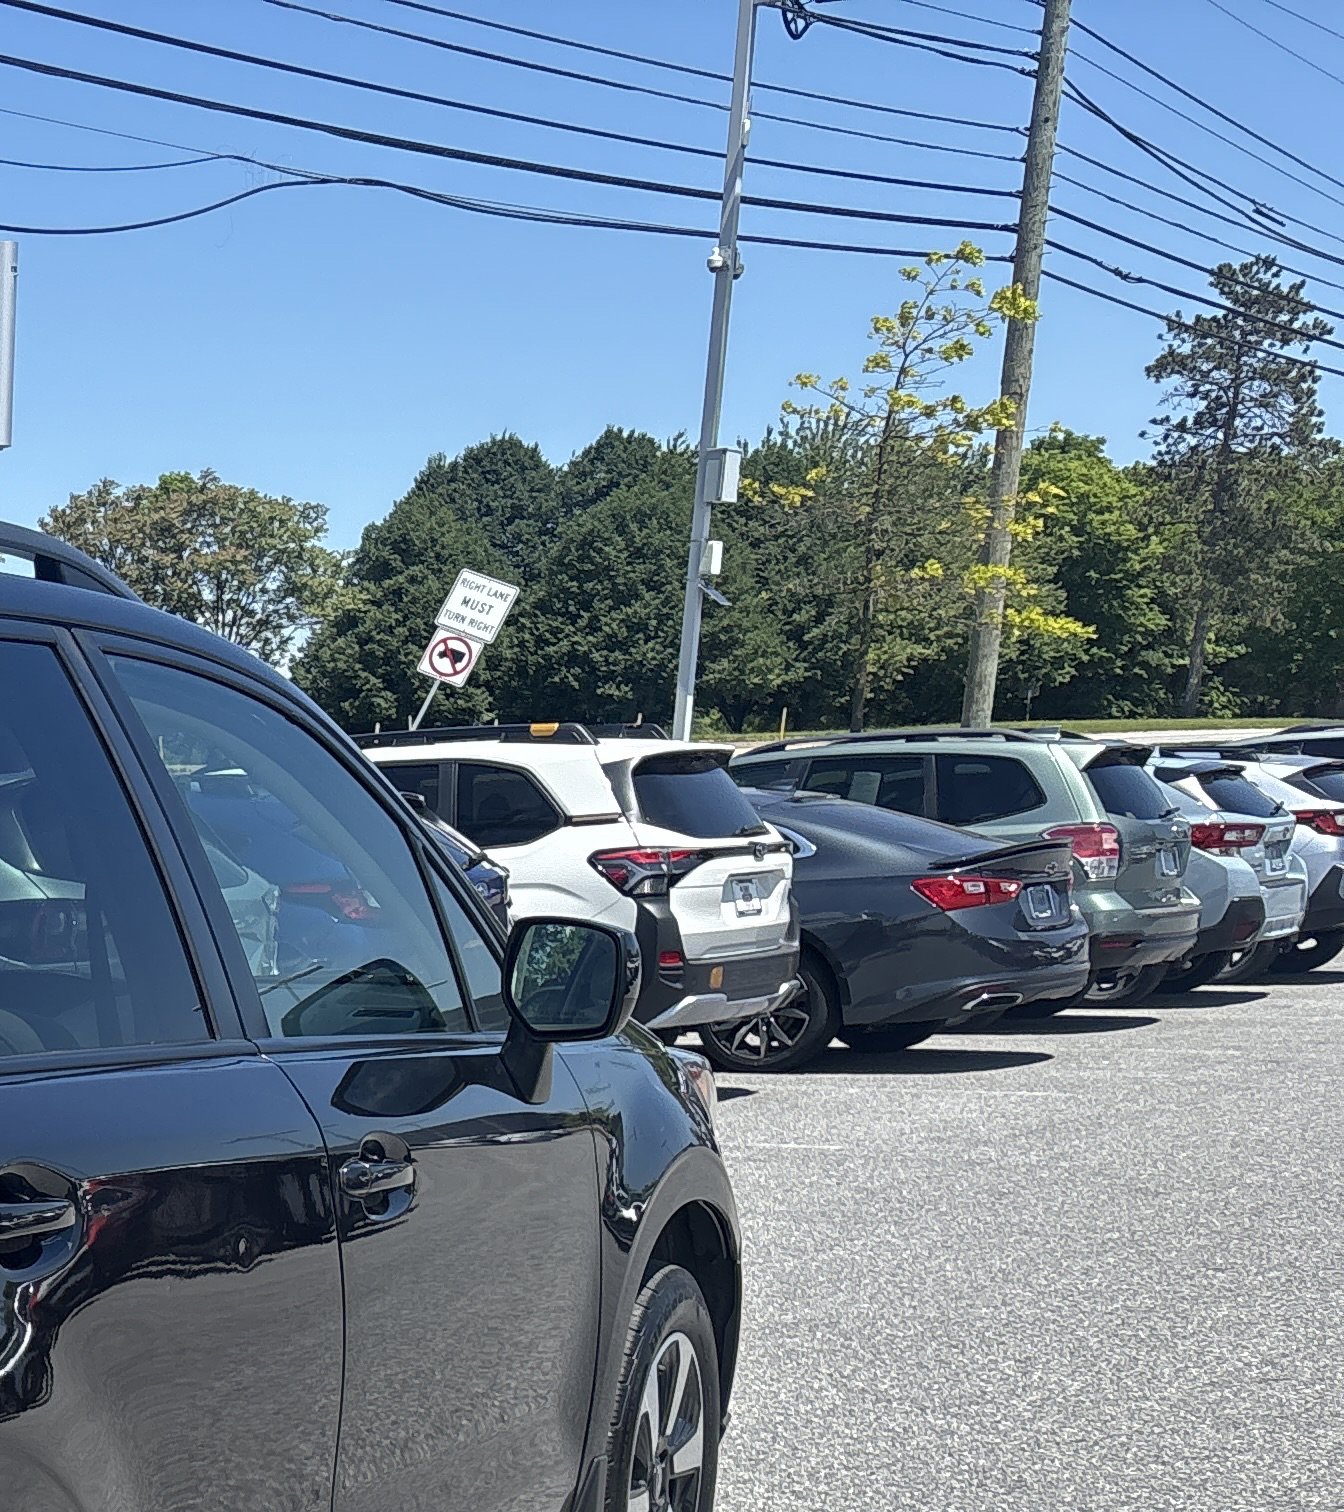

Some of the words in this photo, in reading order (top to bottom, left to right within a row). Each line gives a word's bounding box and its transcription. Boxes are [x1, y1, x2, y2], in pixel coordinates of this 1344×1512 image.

[460, 578, 487, 593] RIGHT
[487, 588, 511, 602] LANE
[461, 596, 494, 615] MUST
[444, 609, 466, 624] TURN
[468, 619, 495, 634] RIGHT
